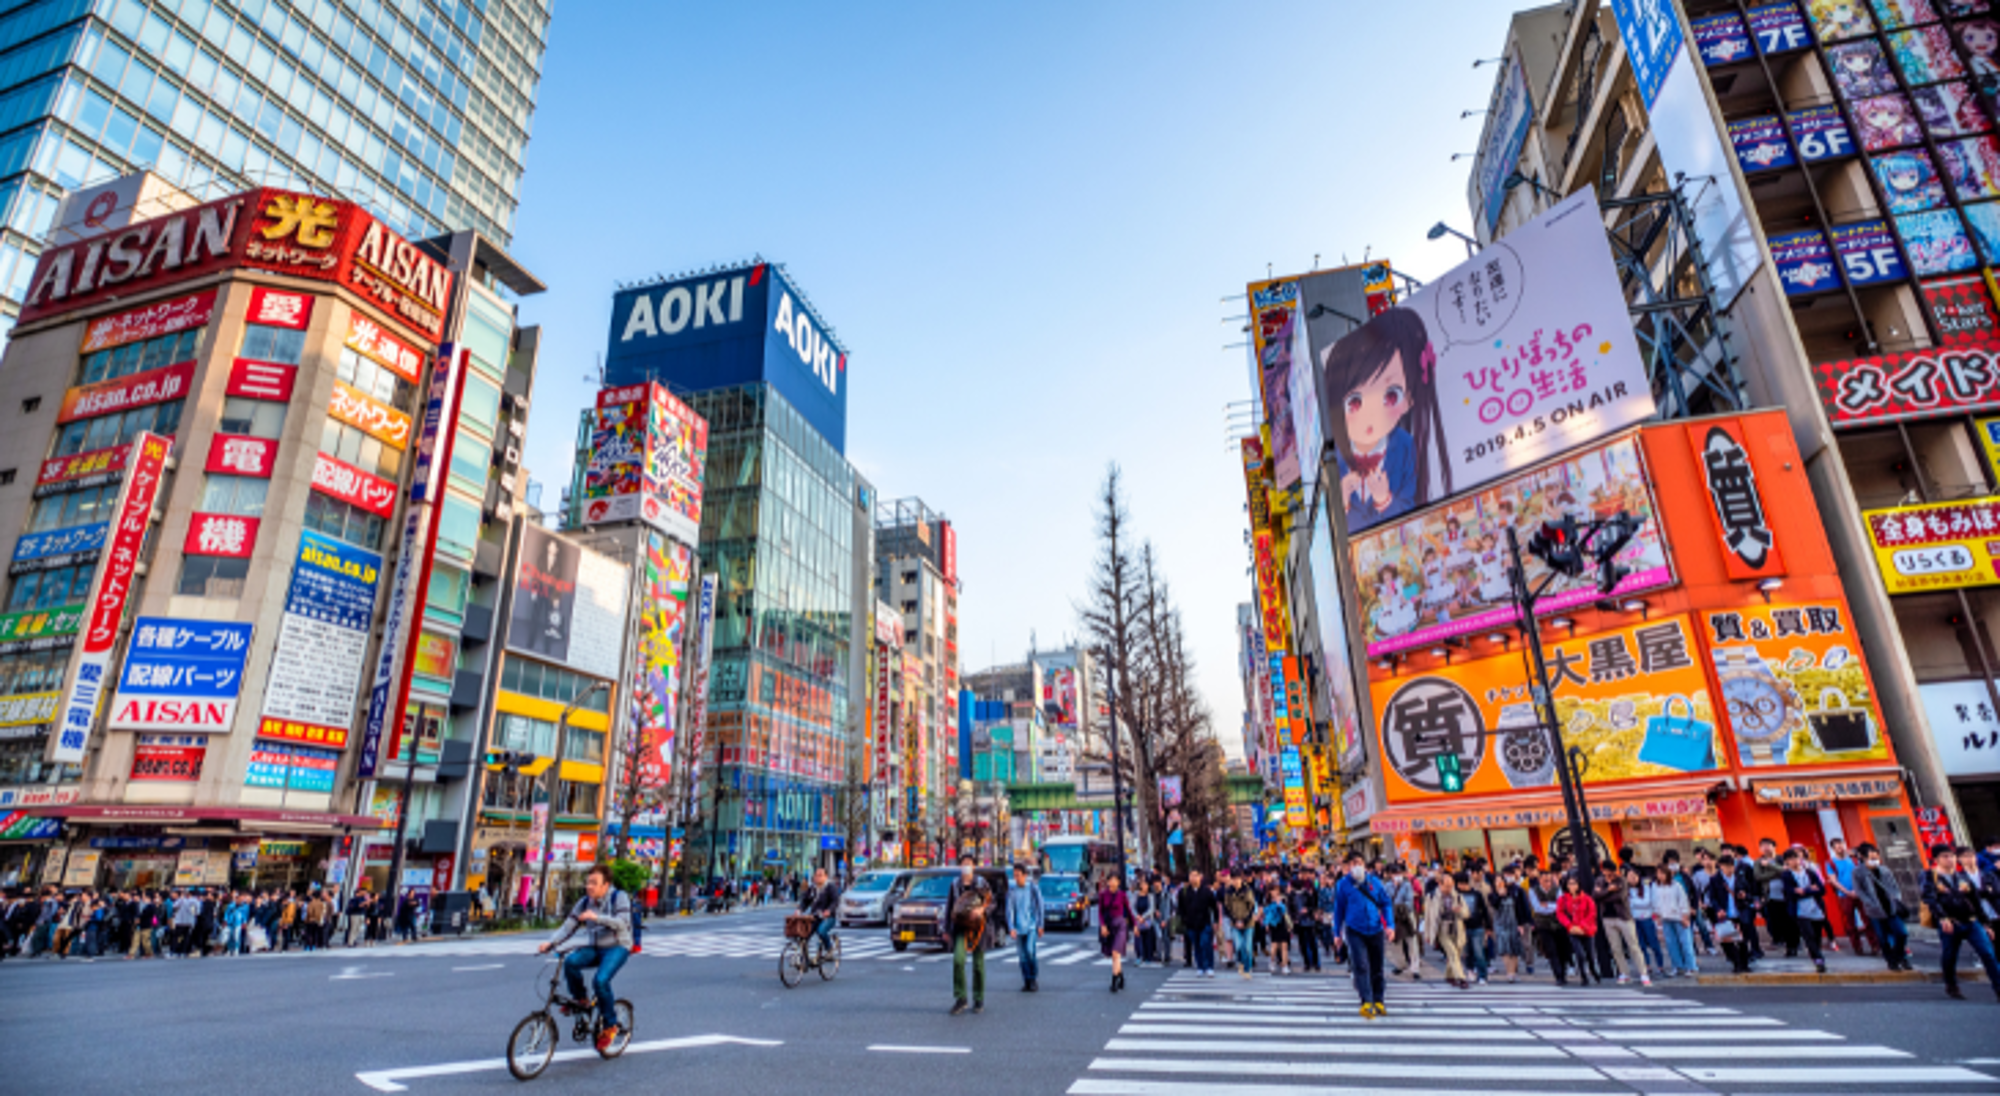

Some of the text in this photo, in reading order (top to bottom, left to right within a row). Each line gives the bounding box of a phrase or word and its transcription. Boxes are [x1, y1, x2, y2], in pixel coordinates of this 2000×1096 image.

[1758, 23, 1807, 53] 7F
[1799, 127, 1850, 158] 6F
[262, 194, 338, 249] 光
[27, 198, 245, 307] AISAN
[245, 242, 338, 269] ネットワーク
[357, 219, 451, 312] AISAN
[1843, 246, 1900, 280] 5F
[621, 276, 745, 342] AOKI
[774, 291, 837, 396] AOKI
[1463, 323, 1593, 393] ひとりぼっちの
[73, 374, 182, 416] aisan.co.jp
[1837, 350, 1994, 413] メイド
[199, 292, 302, 552] 愛 三 電 機
[331, 391, 410, 442] ネットワーク
[1463, 380, 1629, 465] 2019.4.5 ON AIR
[1703, 442, 1773, 554] 質
[91, 440, 164, 643] 光・ケーブル・ネットワーク
[1879, 507, 2000, 541] 全身もみほ
[301, 546, 376, 585] aisan.co.jp
[1898, 549, 1967, 572] りらくる
[136, 624, 245, 652] 各種ケーブル
[1709, 605, 1844, 643] 質&買取
[126, 663, 236, 690] 配線パーツ
[1546, 619, 1694, 692] 大黒屋
[116, 699, 228, 725] AISAN
